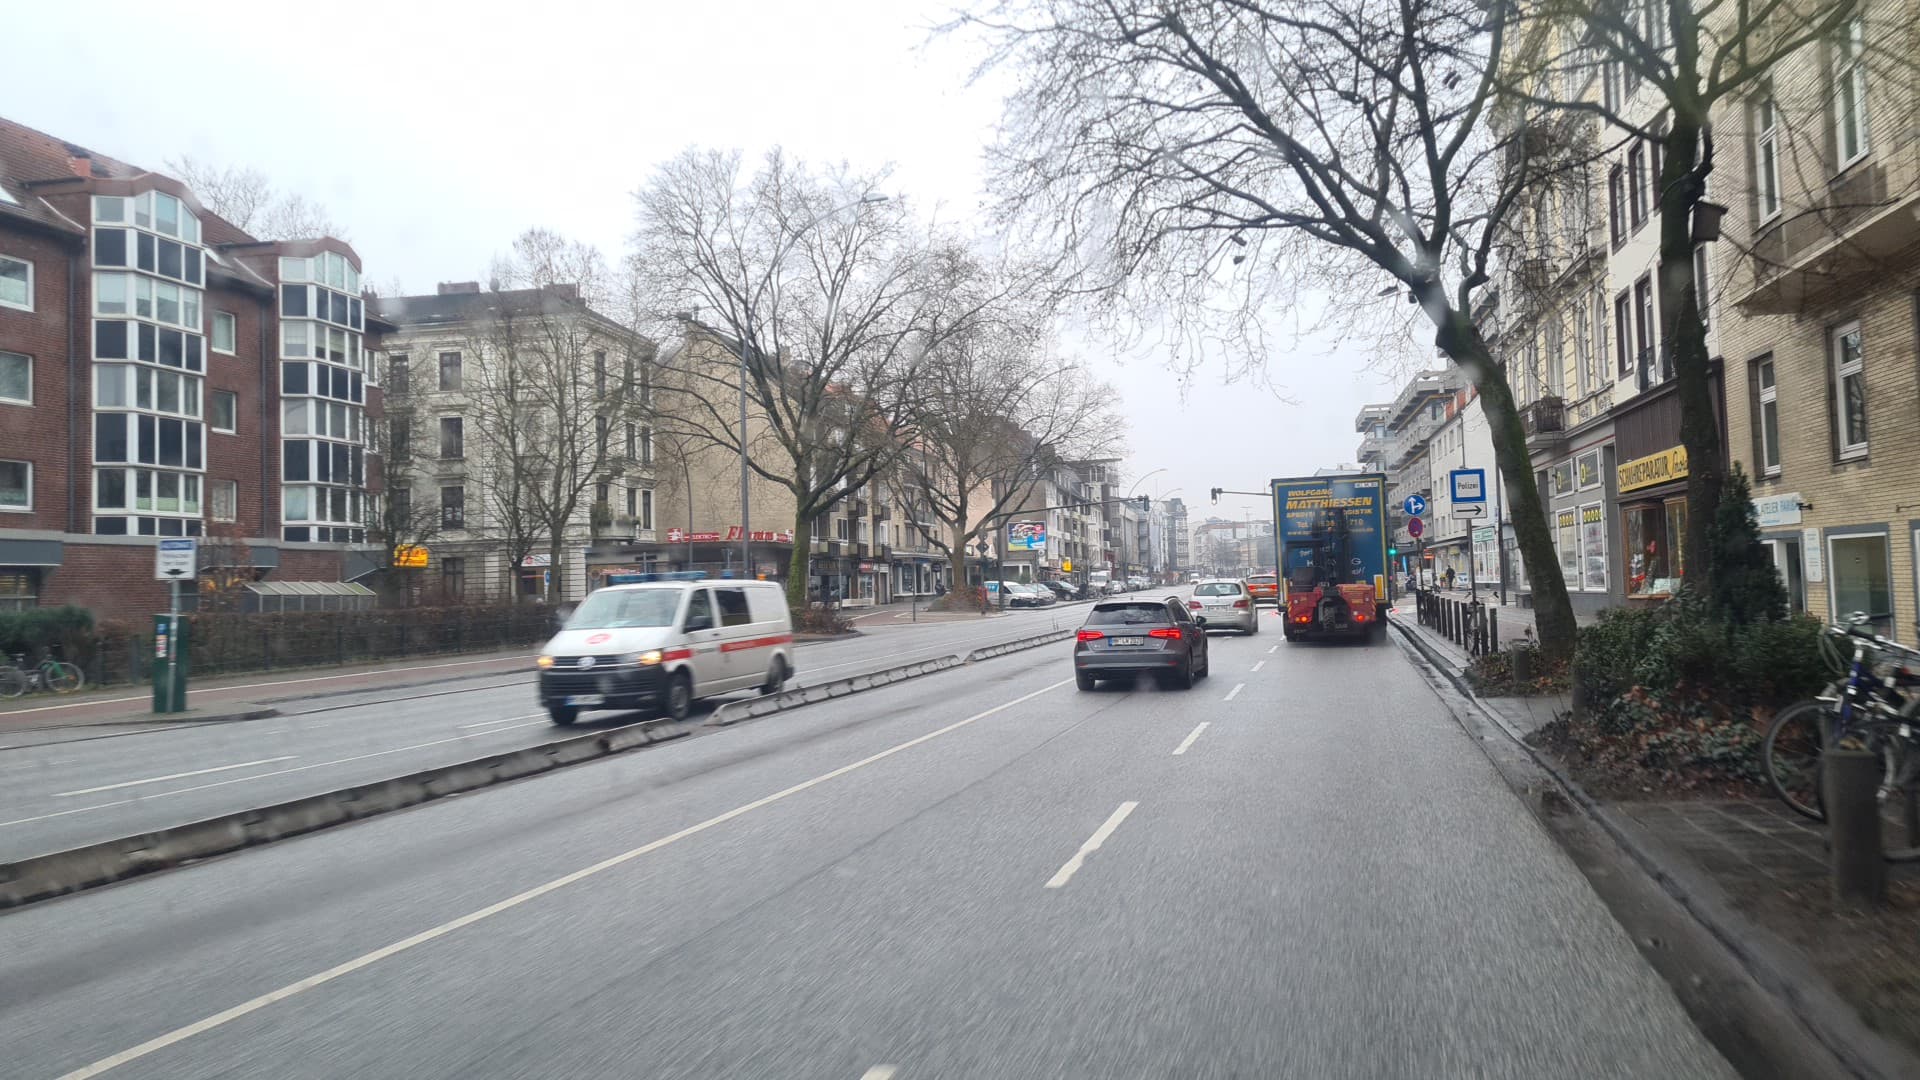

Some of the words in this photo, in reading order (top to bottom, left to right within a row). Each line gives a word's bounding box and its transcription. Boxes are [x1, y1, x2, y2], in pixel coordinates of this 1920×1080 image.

[1619, 456, 1669, 487] SCHUHREPARATUR
[1457, 481, 1479, 490] Polizei
[1288, 488, 1333, 497] WOLFGANG
[1286, 497, 1373, 509] MATTHIESSEN
